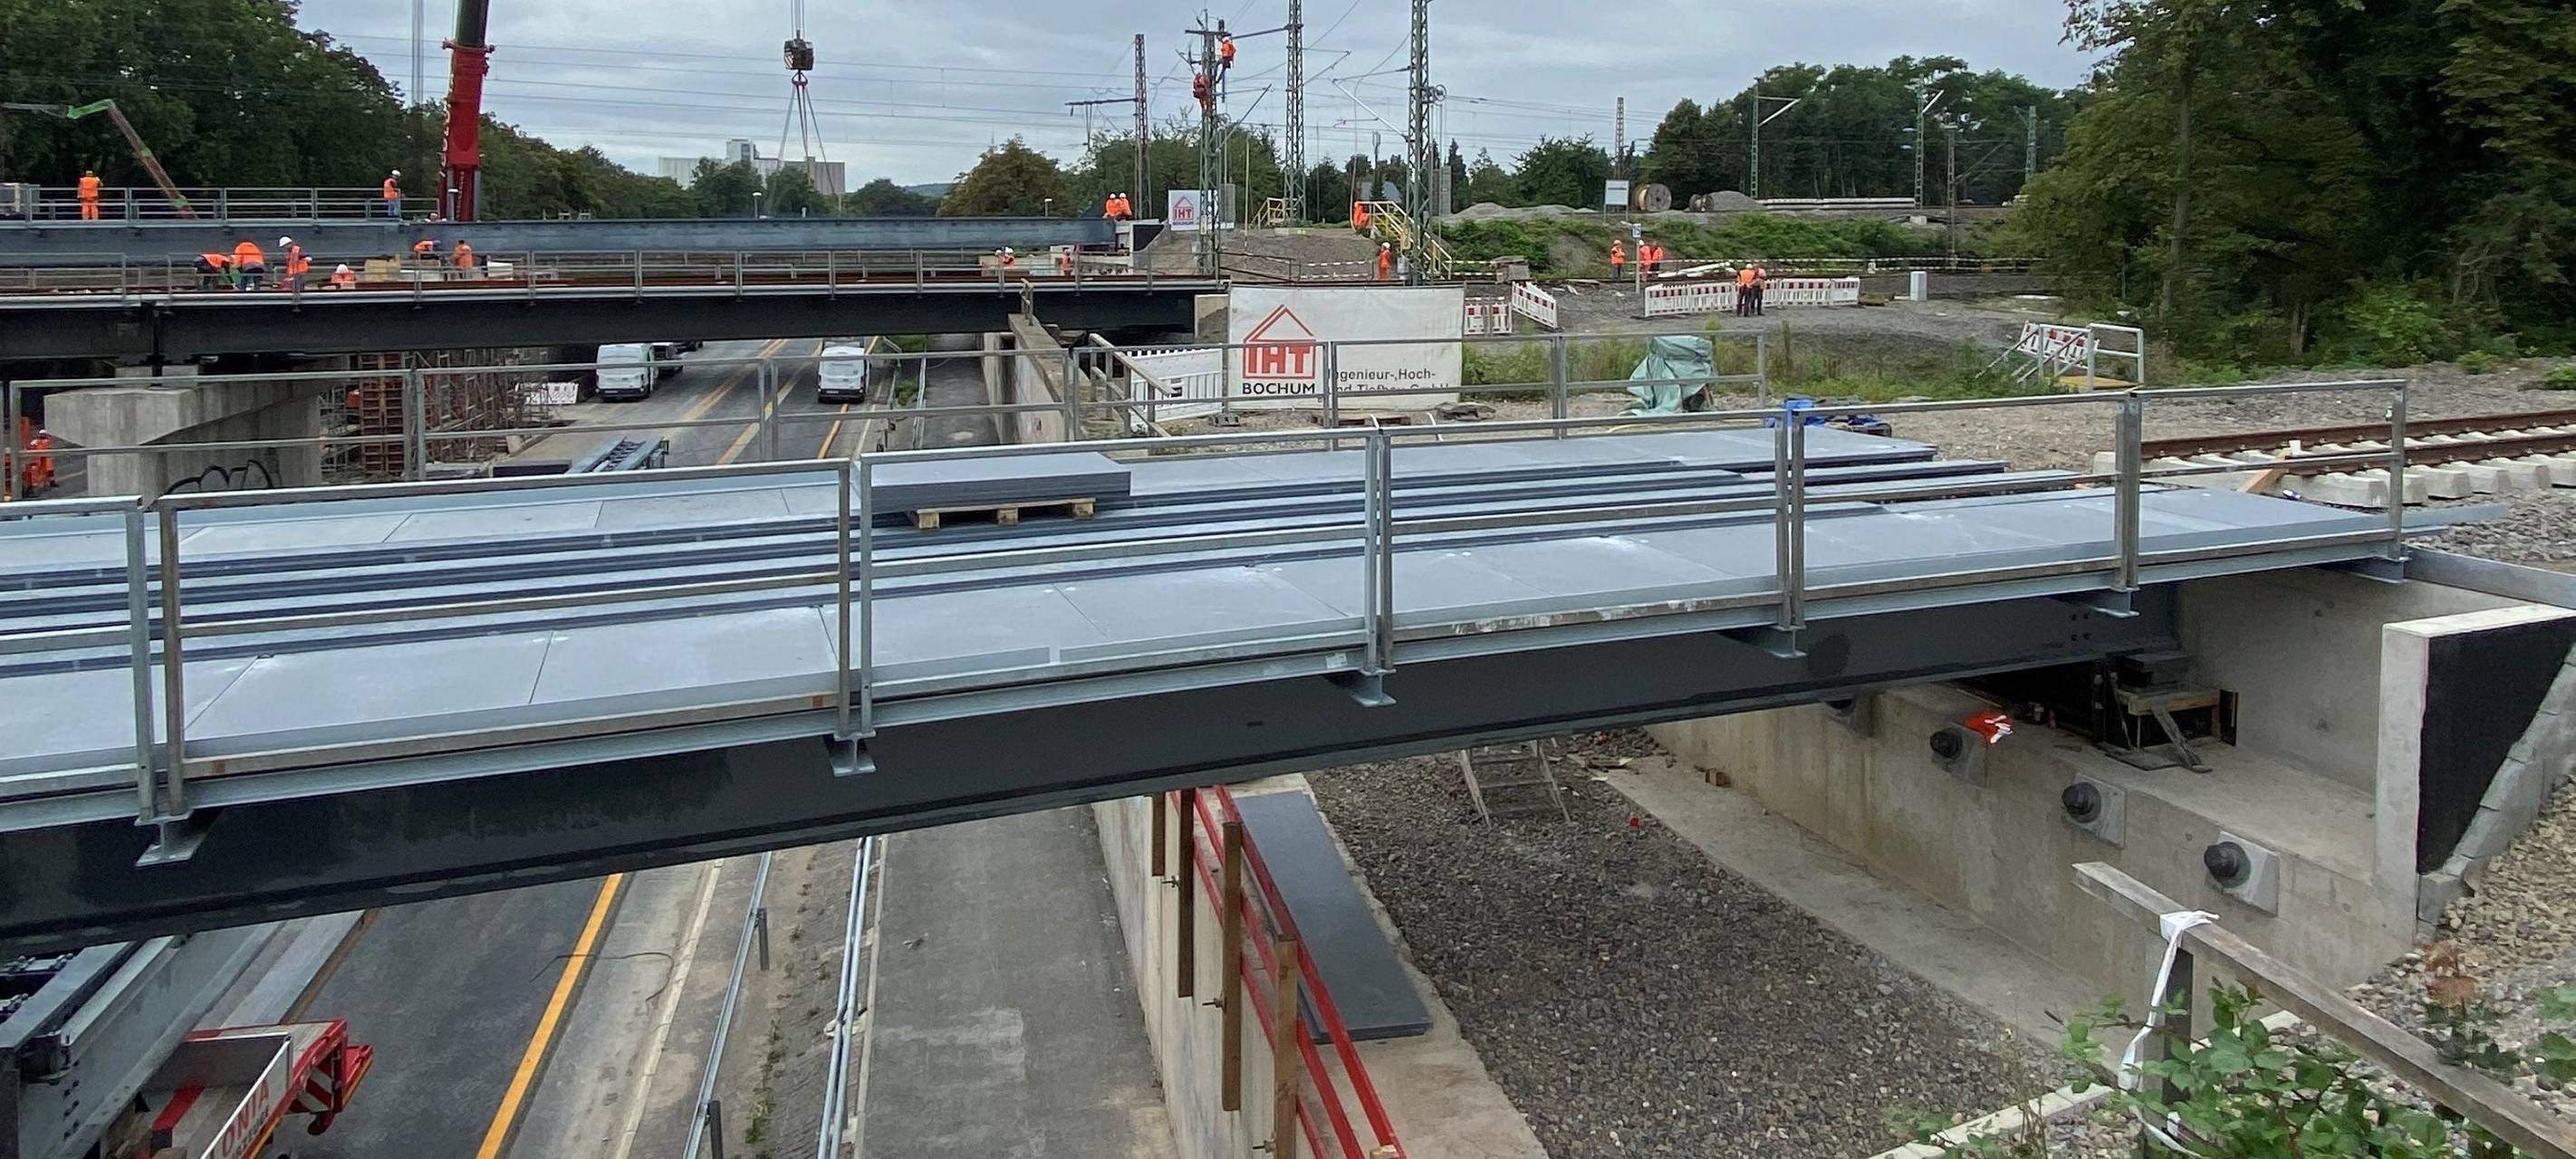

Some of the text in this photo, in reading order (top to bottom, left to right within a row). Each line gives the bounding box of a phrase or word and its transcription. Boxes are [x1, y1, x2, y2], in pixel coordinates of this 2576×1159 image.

[1174, 208, 1192, 218] IHT
[1248, 344, 1311, 374] IHT
[1242, 382, 1315, 395] BOCHUM
